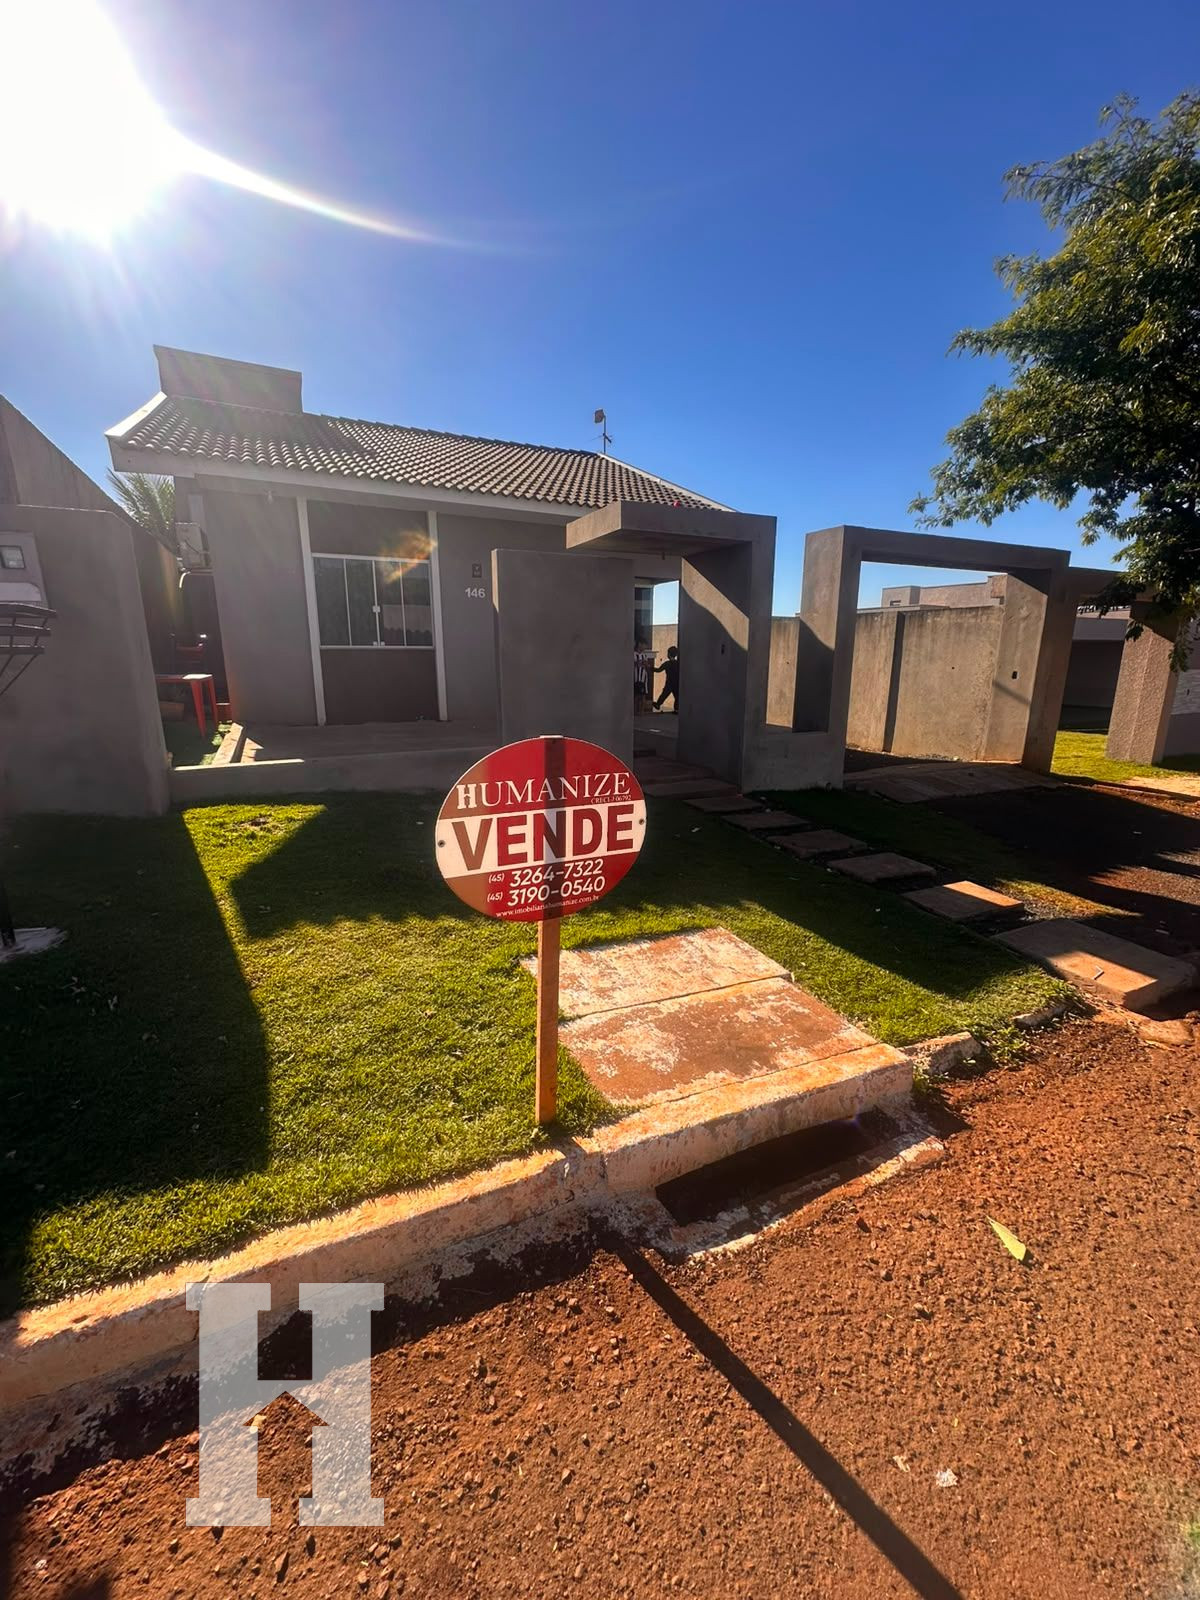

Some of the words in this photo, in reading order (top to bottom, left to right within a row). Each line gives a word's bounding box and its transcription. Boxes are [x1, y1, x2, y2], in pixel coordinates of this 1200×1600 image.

[465, 587, 486, 599] 146
[456, 772, 630, 809] HUMANIZE
[451, 804, 634, 871] VENDE
[488, 873, 505, 884] (45)
[509, 859, 604, 887] 3264-7322
[487, 892, 503, 903] (45)
[507, 876, 606, 906] 3190-0540
